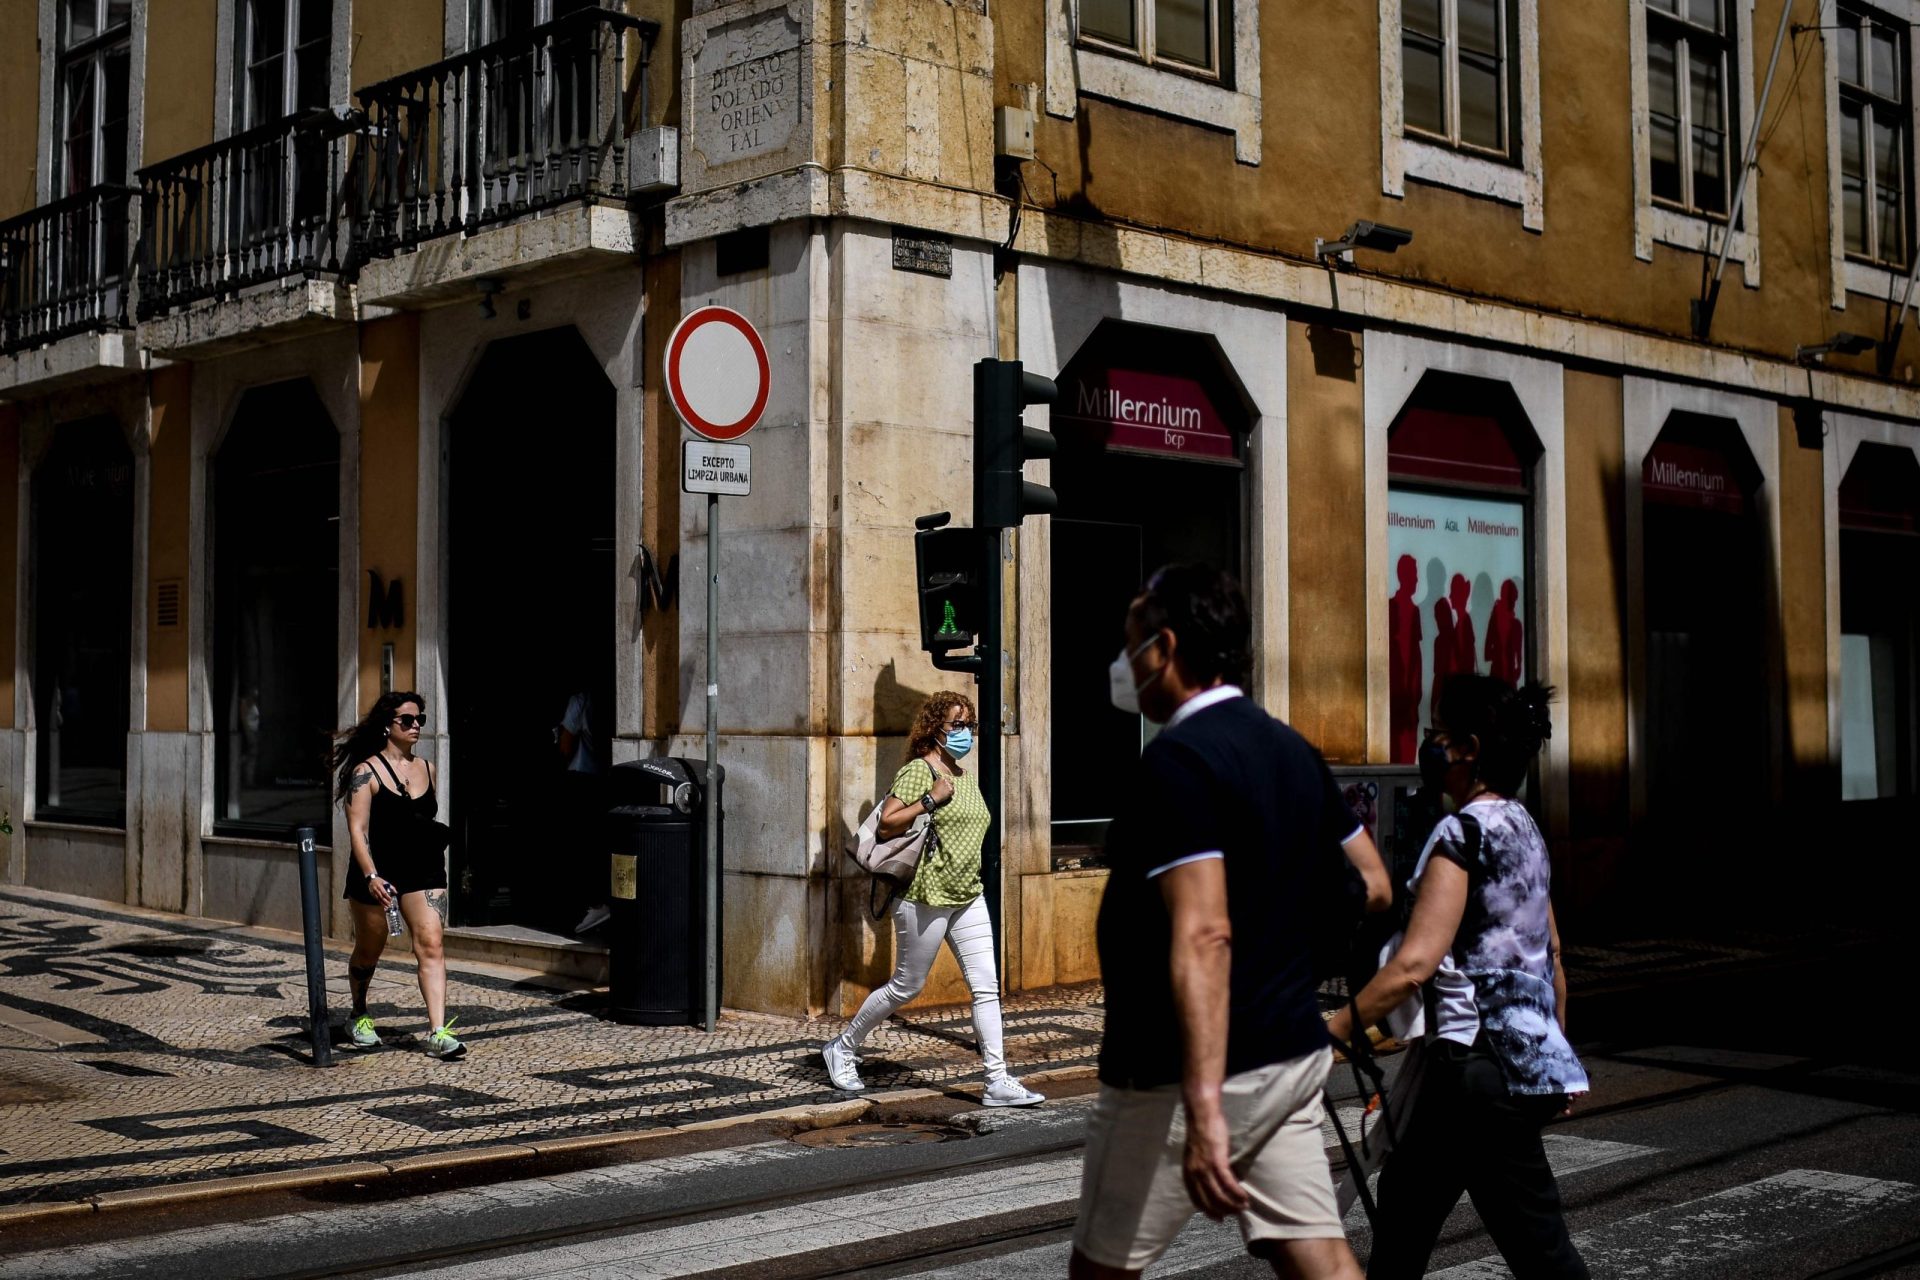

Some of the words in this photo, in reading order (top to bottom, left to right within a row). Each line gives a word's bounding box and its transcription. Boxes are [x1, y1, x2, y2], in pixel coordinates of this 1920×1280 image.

[728, 129, 766, 152] TAL
[1076, 378, 1201, 430] Millennium
[1164, 429, 1186, 450] bcp
[702, 456, 735, 468] EXCEPTO
[1651, 454, 1724, 491] Millennium
[688, 469, 718, 482] LIMPEZA
[719, 472, 748, 484] URBANA
[1467, 516, 1519, 537] Millennium
[366, 570, 403, 628] M
